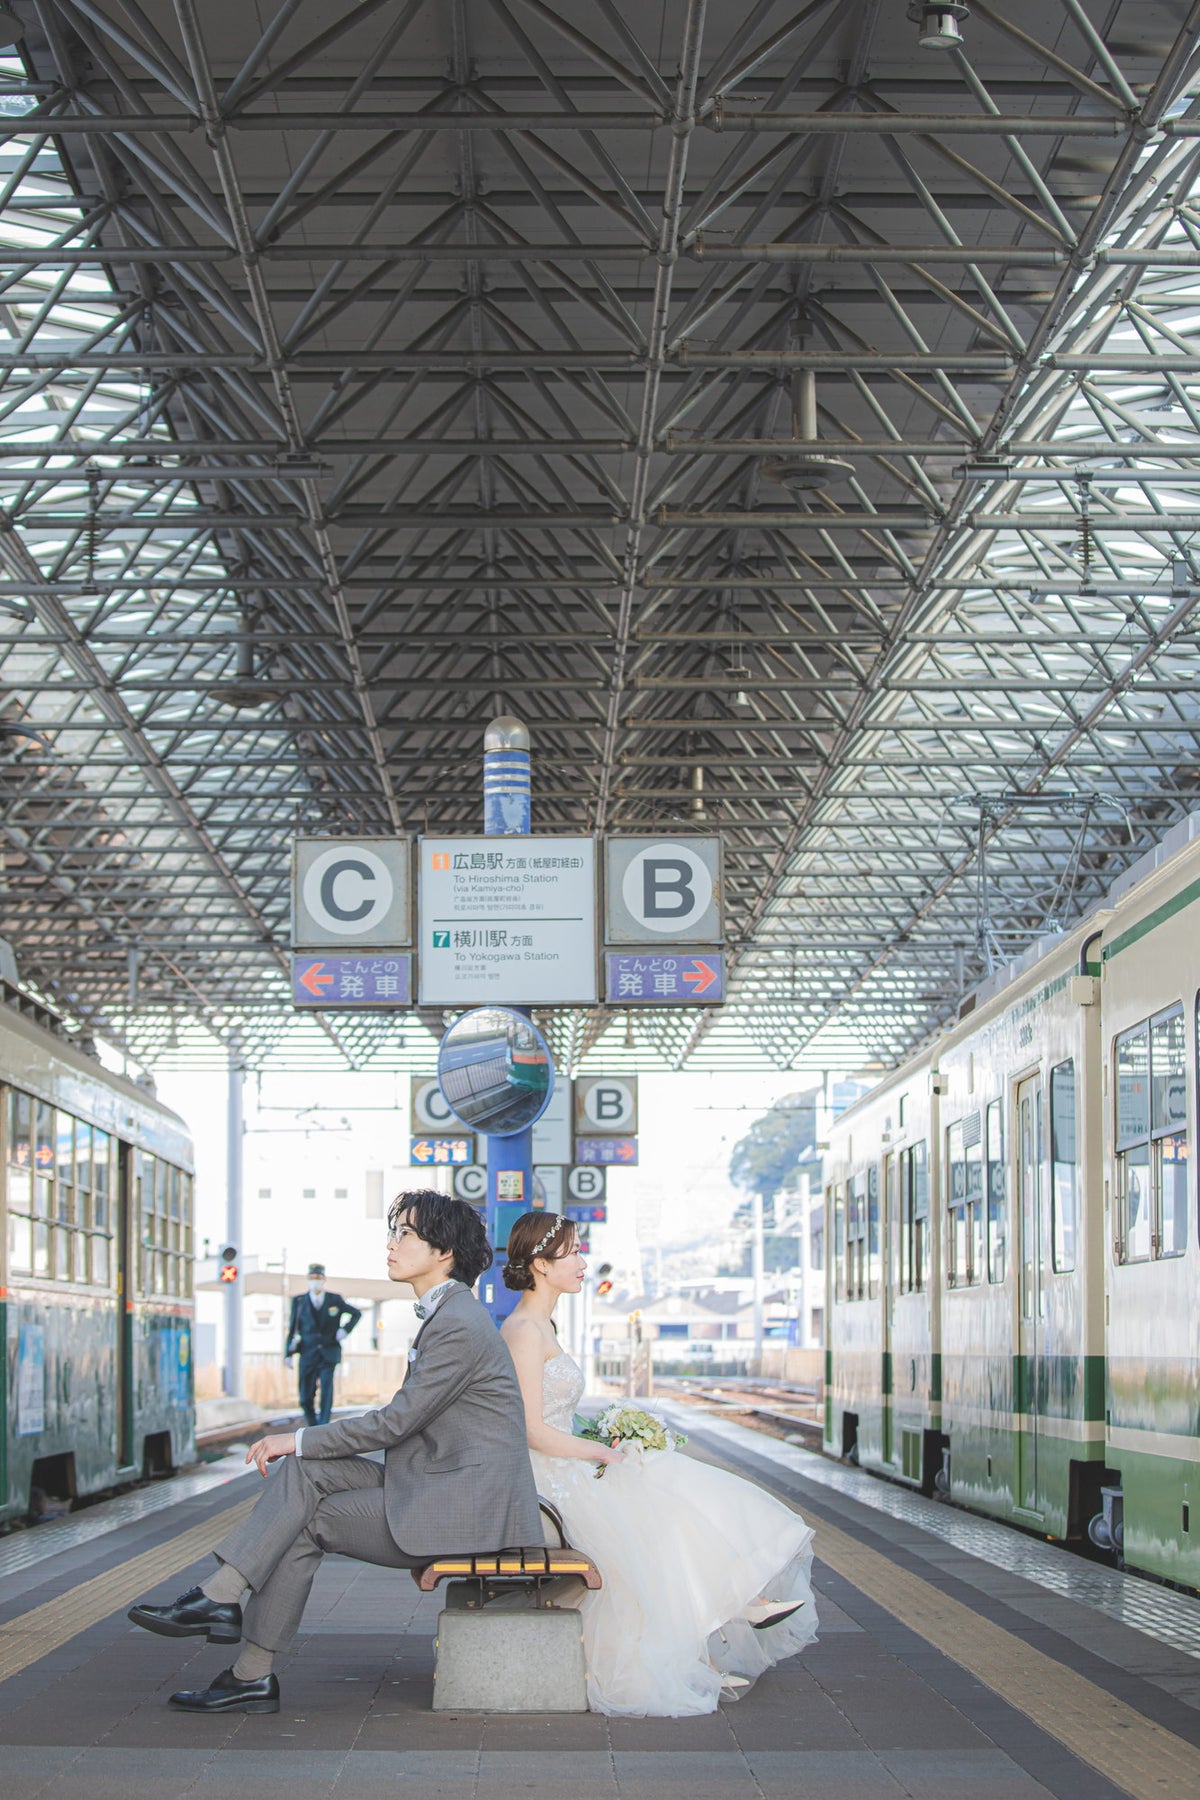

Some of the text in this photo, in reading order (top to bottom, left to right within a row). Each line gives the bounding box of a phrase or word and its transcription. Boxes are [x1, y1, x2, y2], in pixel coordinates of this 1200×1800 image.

[453, 874, 558, 883] To Hiroshima Station
[643, 859, 696, 919] B
[320, 859, 376, 922] C
[435, 931, 448, 947] 7
[340, 961, 399, 974] こんどの
[454, 952, 559, 962] To Yokogawa Station
[618, 959, 677, 972] こんどの
[340, 975, 399, 998] 発車
[618, 973, 677, 996] 発車
[596, 1089, 624, 1120] B
[463, 1171, 482, 1193] C
[578, 1171, 596, 1193] B
